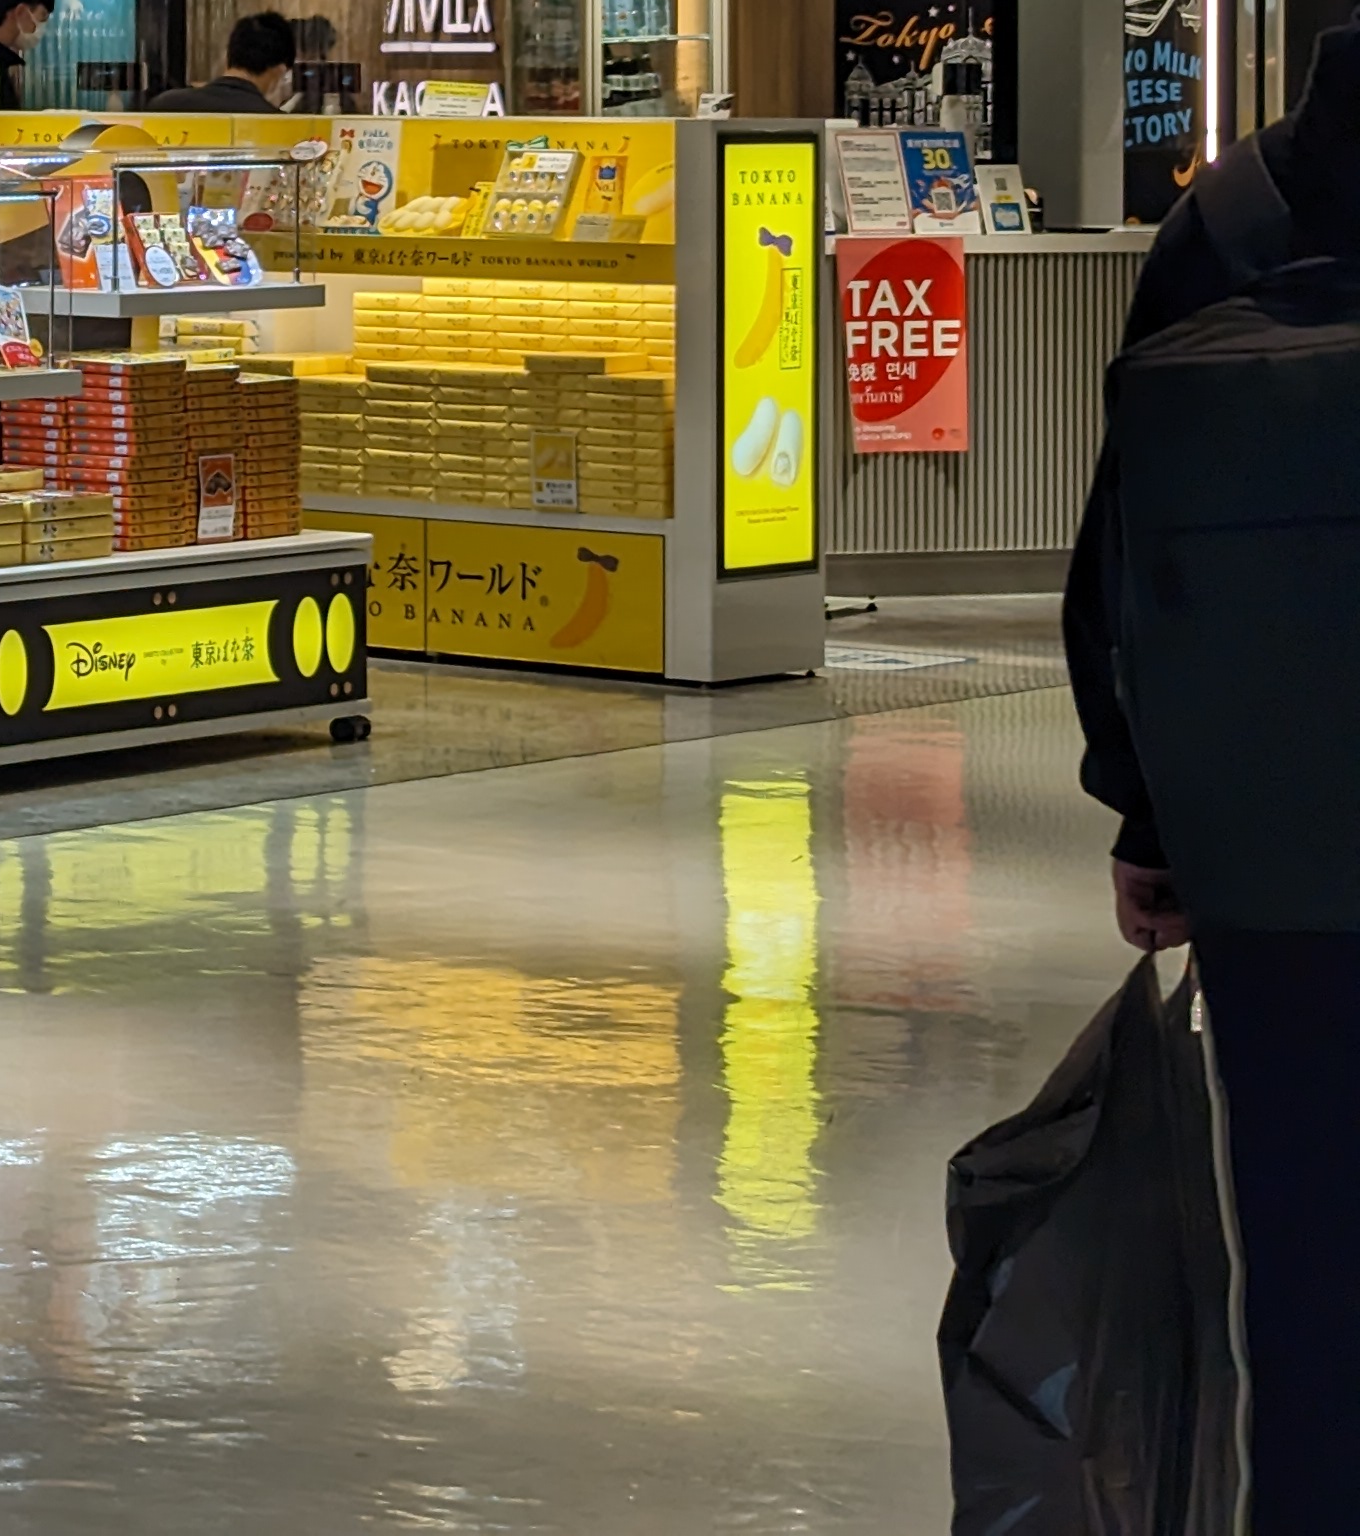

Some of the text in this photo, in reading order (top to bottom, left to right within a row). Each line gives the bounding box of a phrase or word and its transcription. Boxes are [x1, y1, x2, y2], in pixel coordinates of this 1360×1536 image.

[839, 11, 957, 71] Tokyo
[372, 80, 505, 117] KAA
[738, 170, 797, 184] TOKYO
[921, 148, 951, 170] 30
[731, 192, 805, 207] BANANA
[846, 279, 934, 318] TAX
[846, 319, 962, 358] FREE
[404, 603, 537, 632] BANANA
[66, 642, 136, 681] Disney
